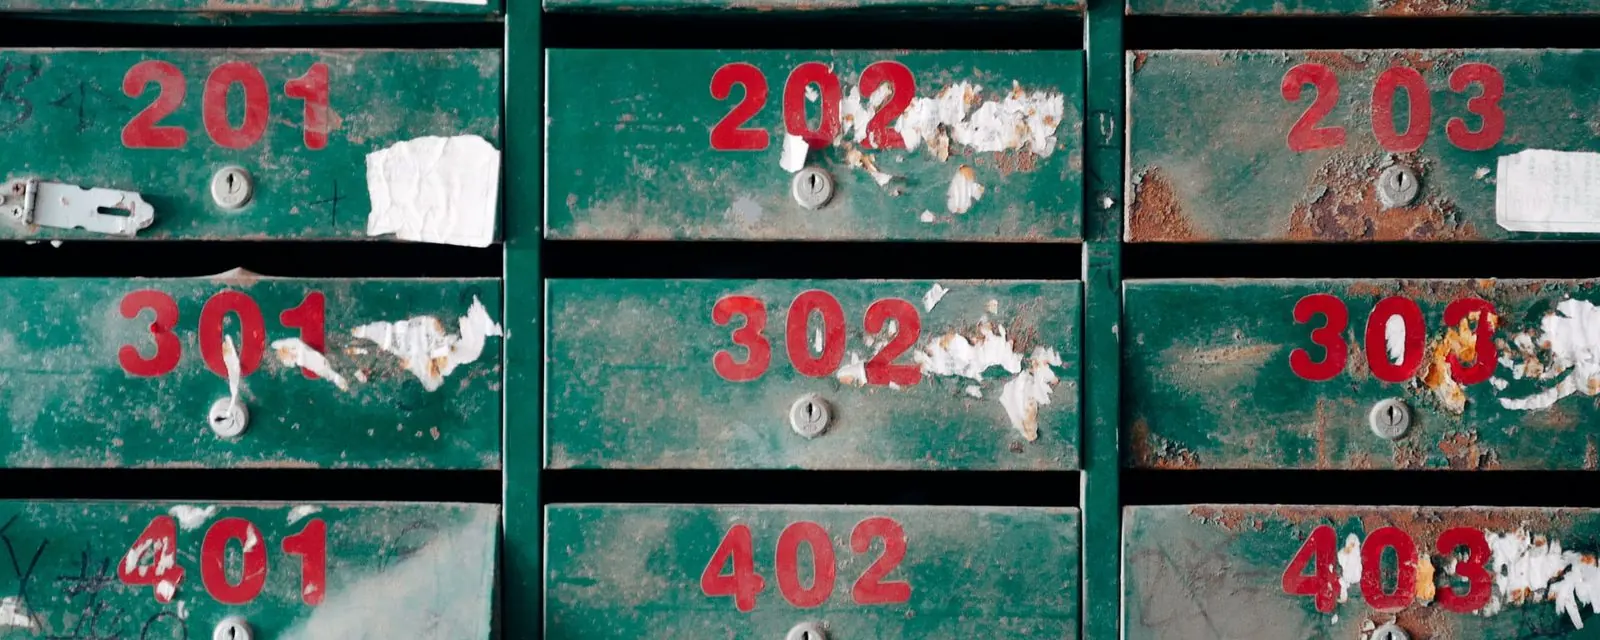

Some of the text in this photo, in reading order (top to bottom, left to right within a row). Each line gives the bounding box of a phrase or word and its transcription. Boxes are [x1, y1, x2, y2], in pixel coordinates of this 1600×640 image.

[120, 60, 329, 150] 201
[709, 60, 917, 151] 202
[1280, 62, 1506, 153] 203
[118, 289, 327, 380] 301
[711, 289, 923, 386] 302
[1289, 292, 1500, 385] 303
[118, 515, 328, 606] 401
[700, 516, 912, 612] 402
[1281, 525, 1494, 613] 403
